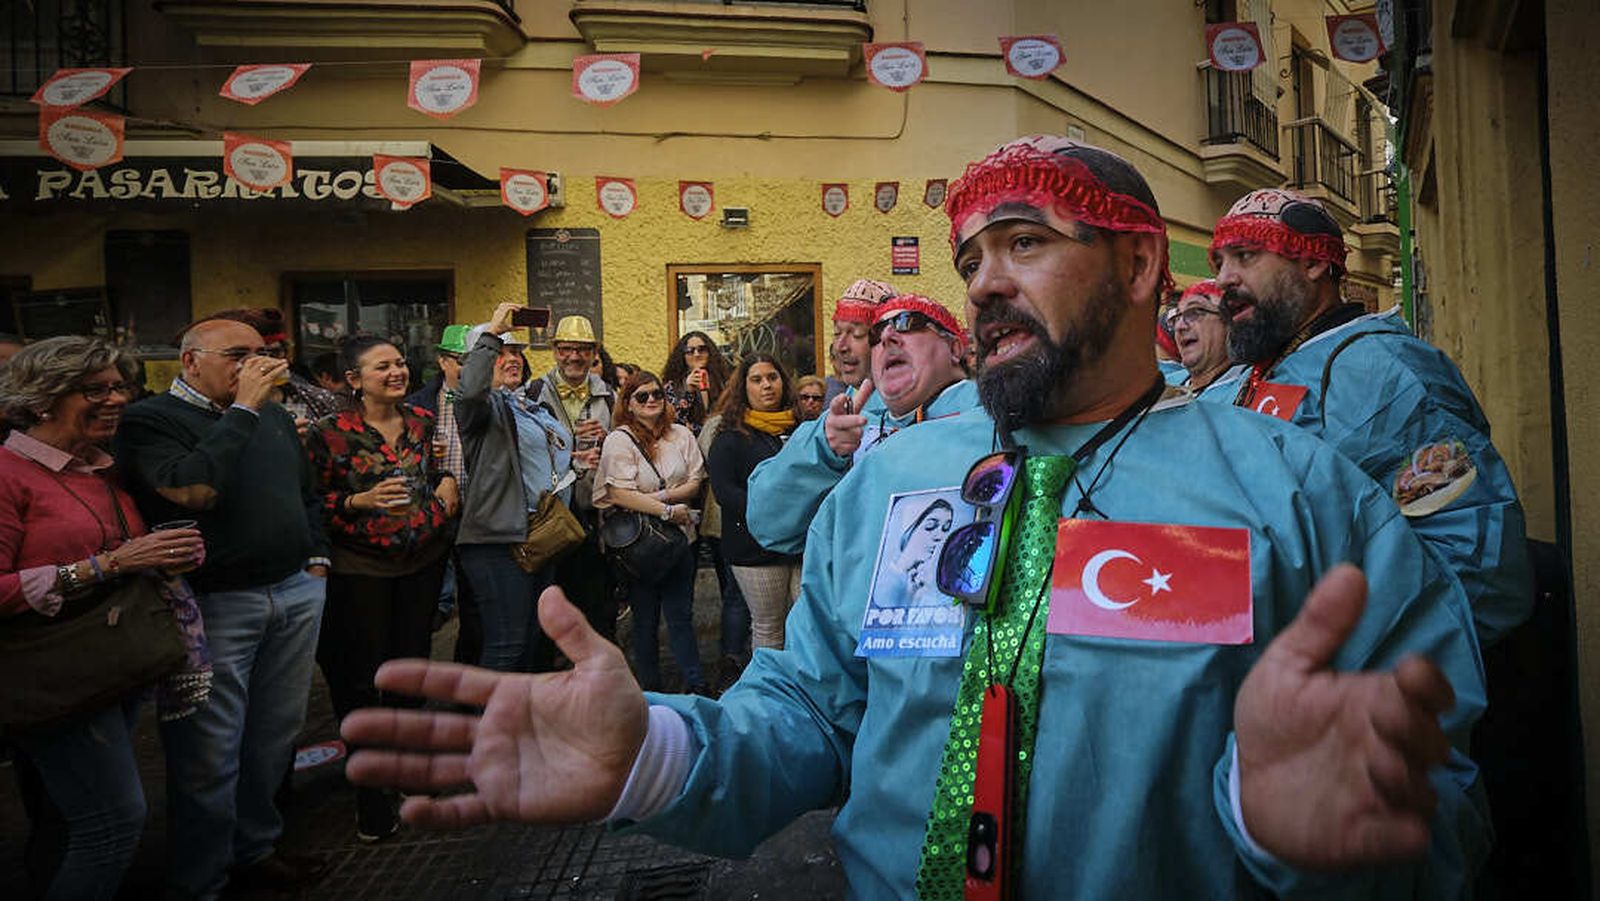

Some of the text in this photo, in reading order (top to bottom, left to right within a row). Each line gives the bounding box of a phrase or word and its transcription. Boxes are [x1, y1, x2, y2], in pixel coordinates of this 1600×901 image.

[866, 606, 960, 626] POR FAVOR
[862, 637, 894, 649] Amo
